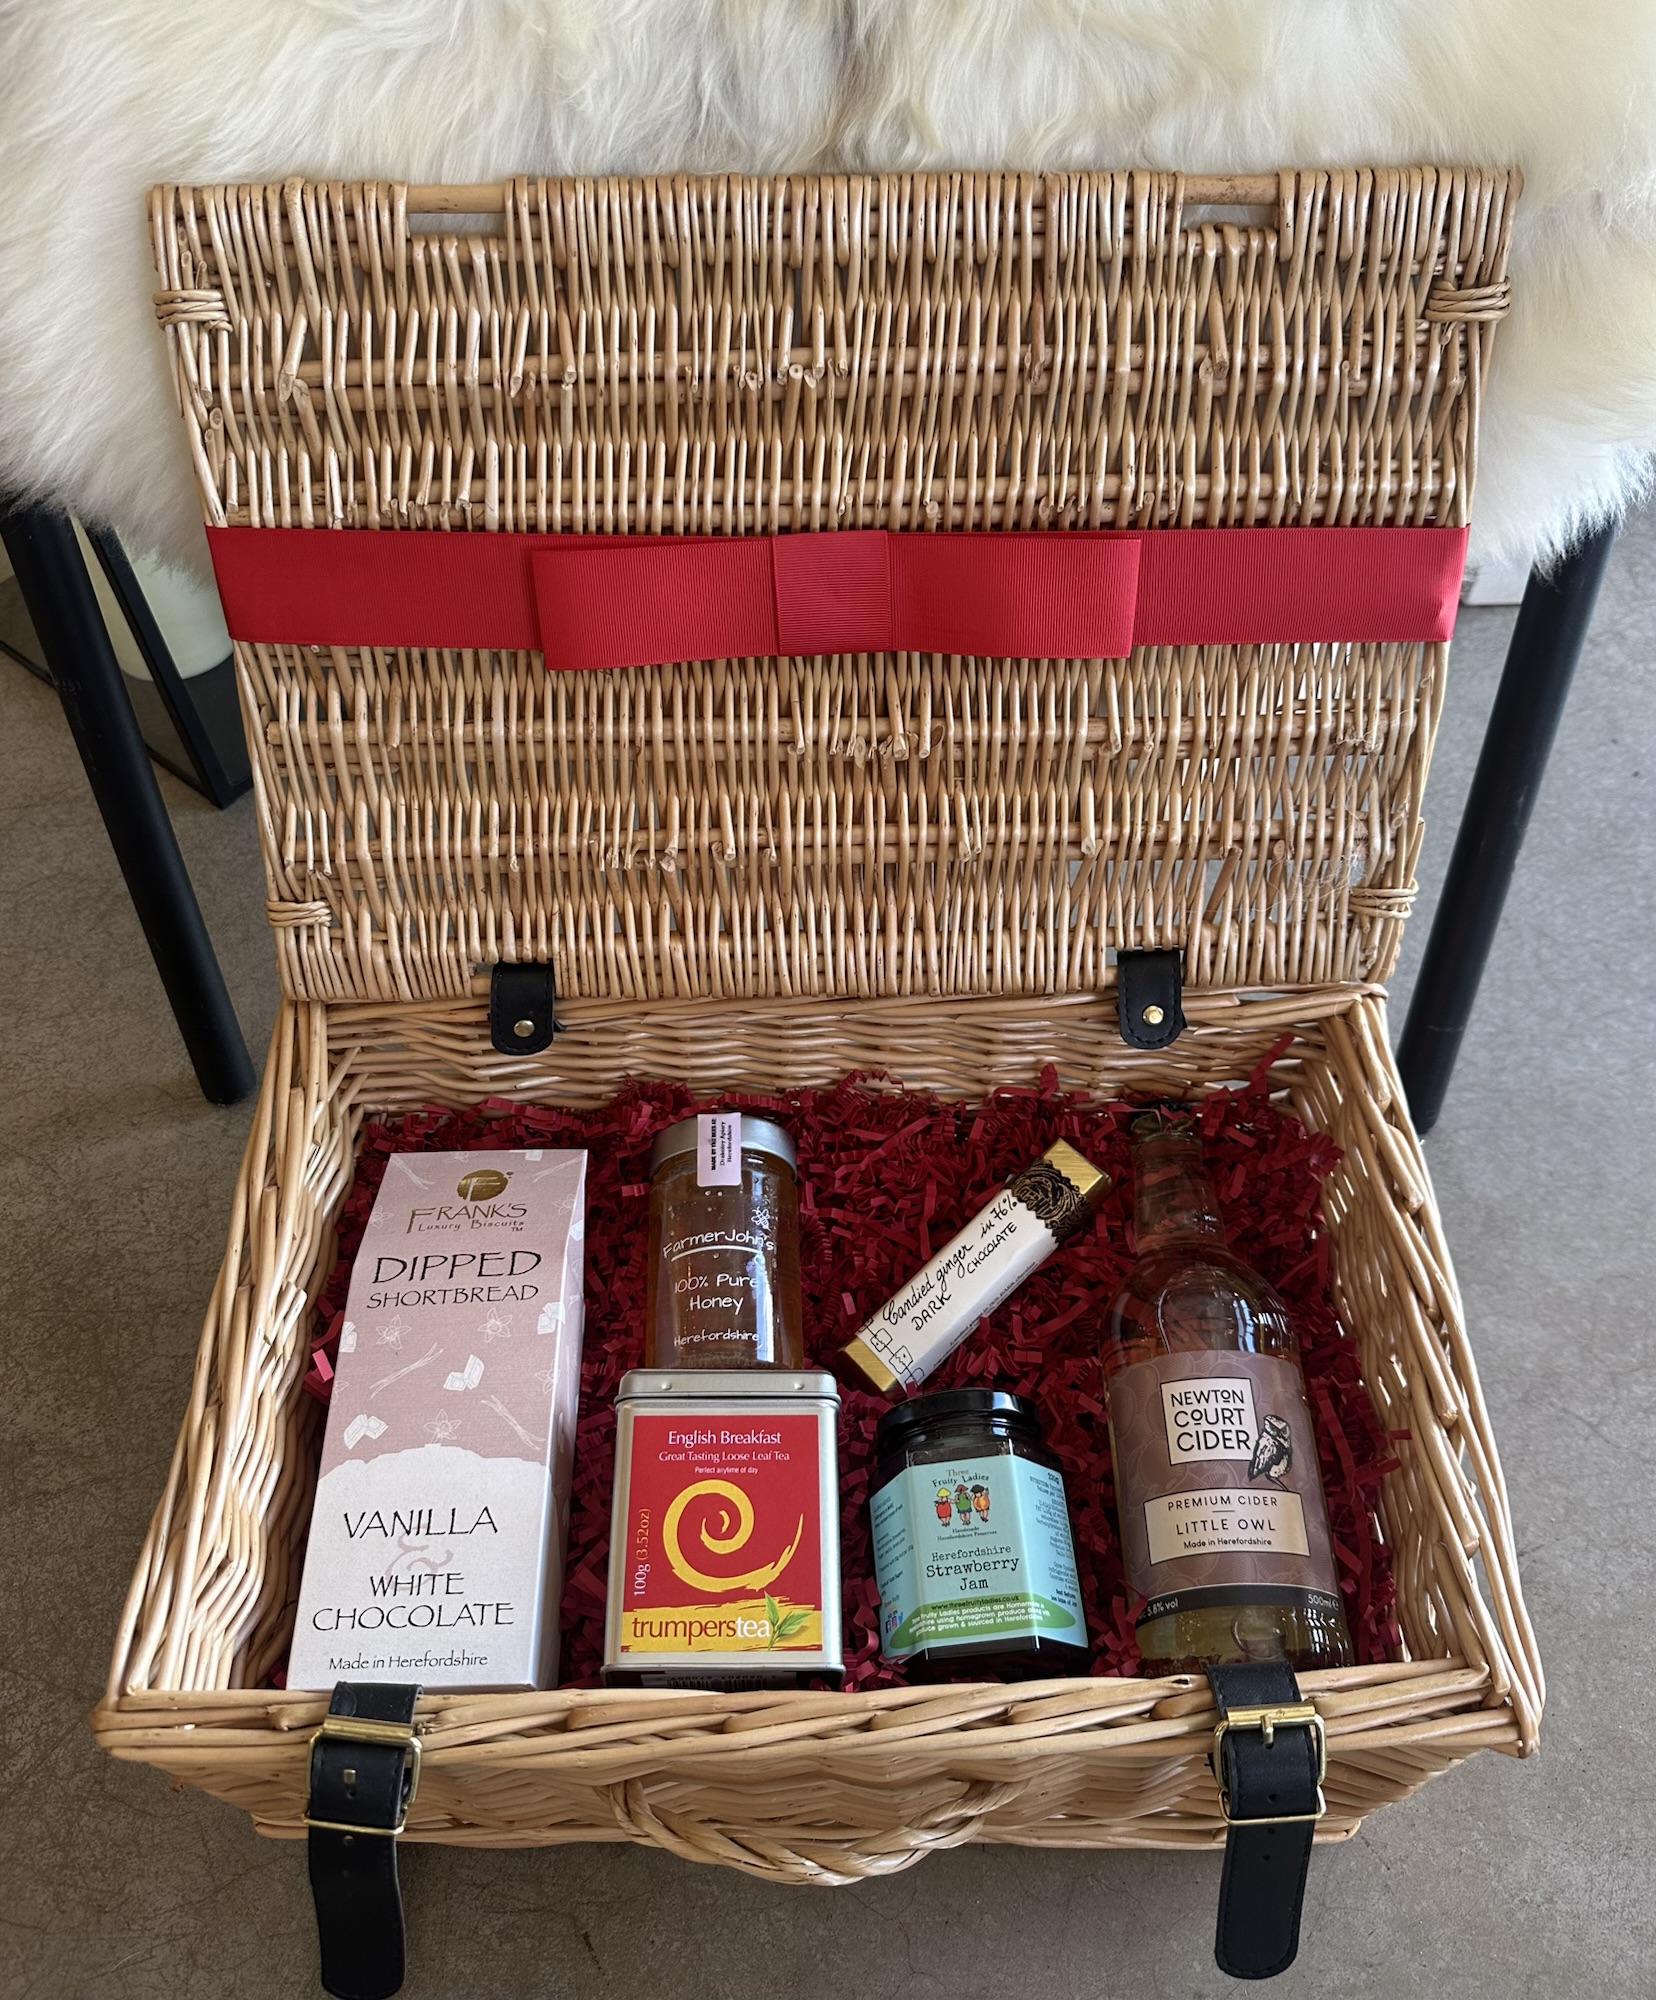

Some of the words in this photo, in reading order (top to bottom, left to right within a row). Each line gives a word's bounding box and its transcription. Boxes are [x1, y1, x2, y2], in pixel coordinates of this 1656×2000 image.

[406, 1202, 528, 1234] FRANK'S
[418, 1222, 461, 1232] Luxury
[470, 1219, 524, 1229] Biscuits
[371, 1250, 542, 1284] DIPPED
[882, 1272, 935, 1326] Candied
[936, 1242, 974, 1292] ginger
[980, 1221, 995, 1239] in
[989, 1193, 1018, 1226] 76%
[674, 1276, 709, 1294] 100%
[716, 1274, 759, 1288] Pure
[911, 1292, 952, 1331] DARK
[967, 1222, 1017, 1275] CHOCOLATE
[366, 1284, 539, 1309] SHORTBREAD
[689, 1294, 744, 1315] Honey
[674, 1328, 761, 1347] Herefordshire
[1171, 1389, 1245, 1408] NEWTON
[1174, 1407, 1246, 1428] COURT
[668, 1430, 717, 1449] English
[720, 1429, 782, 1445] Breakfast
[1176, 1430, 1251, 1452] CIDER
[659, 1451, 686, 1462] Great
[687, 1451, 720, 1464] Tasting
[722, 1451, 750, 1461] Loose
[752, 1450, 773, 1461] Leaf
[774, 1451, 790, 1461] Tea
[694, 1466, 717, 1474] Perfect
[718, 1466, 739, 1475] anytime
[747, 1466, 759, 1475] day
[932, 1476, 957, 1488] Fruity
[962, 1472, 990, 1484] Ladies
[946, 1467, 970, 1478] Three
[1168, 1495, 1231, 1511] PREMIUM
[1238, 1496, 1278, 1507] CIDER
[343, 1506, 498, 1539] VANILLA
[1176, 1519, 1229, 1535] LITTLE
[1237, 1519, 1276, 1531] OWL
[637, 1508, 652, 1561] (3.52oz)
[1183, 1538, 1206, 1549] Made
[1208, 1538, 1216, 1547] in
[1217, 1536, 1272, 1547] Herefordshire
[931, 1544, 1012, 1563] Herefordshire
[926, 1557, 1020, 1579] Strawberry
[370, 1572, 464, 1597] WHITE
[633, 1563, 651, 1596] 100g
[960, 1578, 989, 1592] Jam
[939, 1609, 960, 1618] Ladies
[962, 1605, 991, 1616] products
[1165, 1597, 1179, 1610] vol
[312, 1602, 514, 1631] CHOCOLATE
[937, 1617, 955, 1625] using
[956, 1611, 996, 1622] homegrown
[997, 1608, 1026, 1618] produce
[938, 1623, 960, 1632] grown
[968, 1618, 994, 1627] sourced
[632, 1617, 772, 1645] trumperstea
[329, 1653, 369, 1670] Made
[372, 1655, 385, 1668] in
[388, 1649, 488, 1668] Herefordshire
